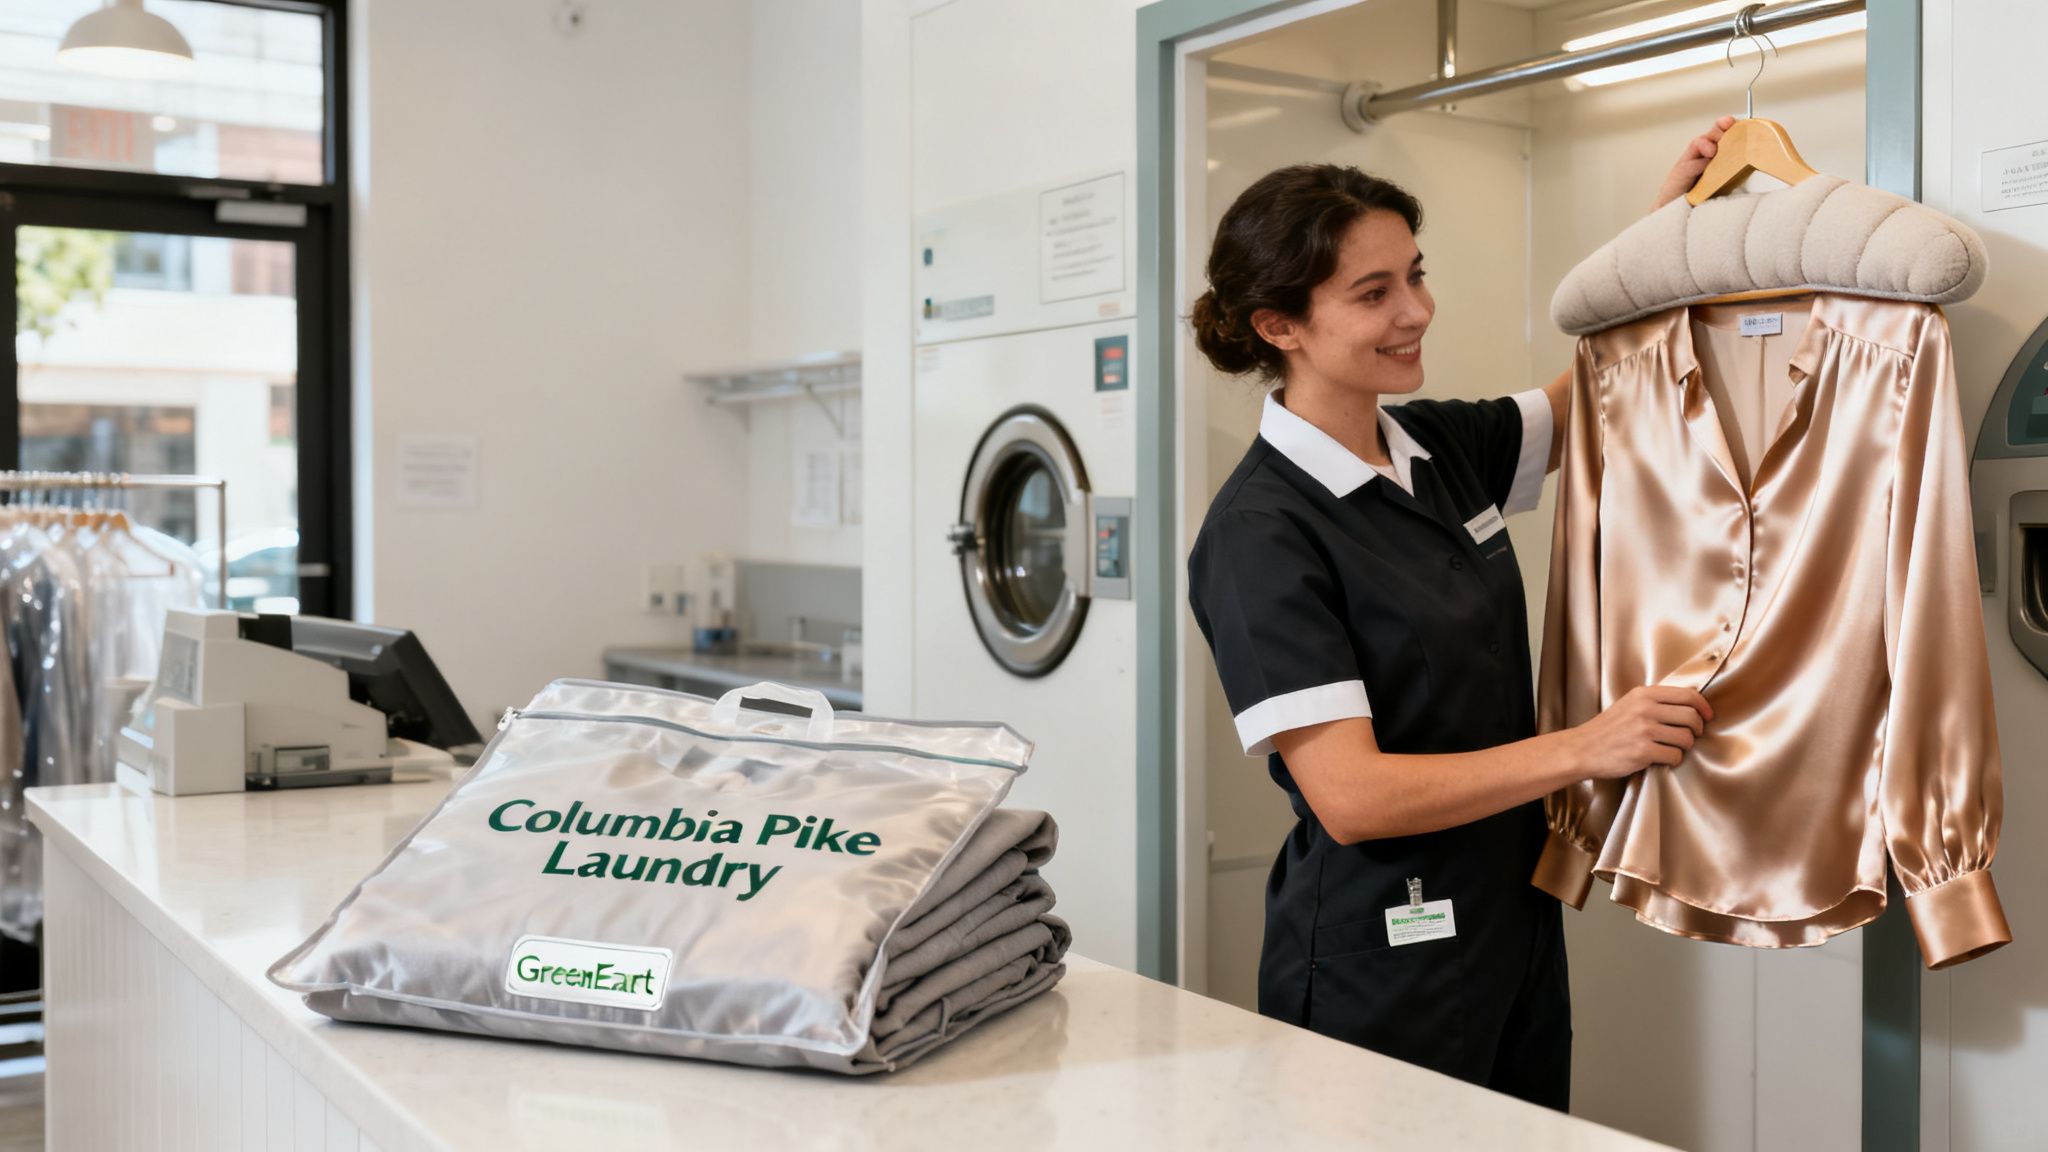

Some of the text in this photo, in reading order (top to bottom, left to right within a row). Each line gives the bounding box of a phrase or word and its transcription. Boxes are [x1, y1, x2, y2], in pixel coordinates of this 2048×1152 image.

[488, 799, 882, 856] Columbia Pike
[541, 840, 783, 901] Laundry
[517, 955, 655, 995] GreenEart
